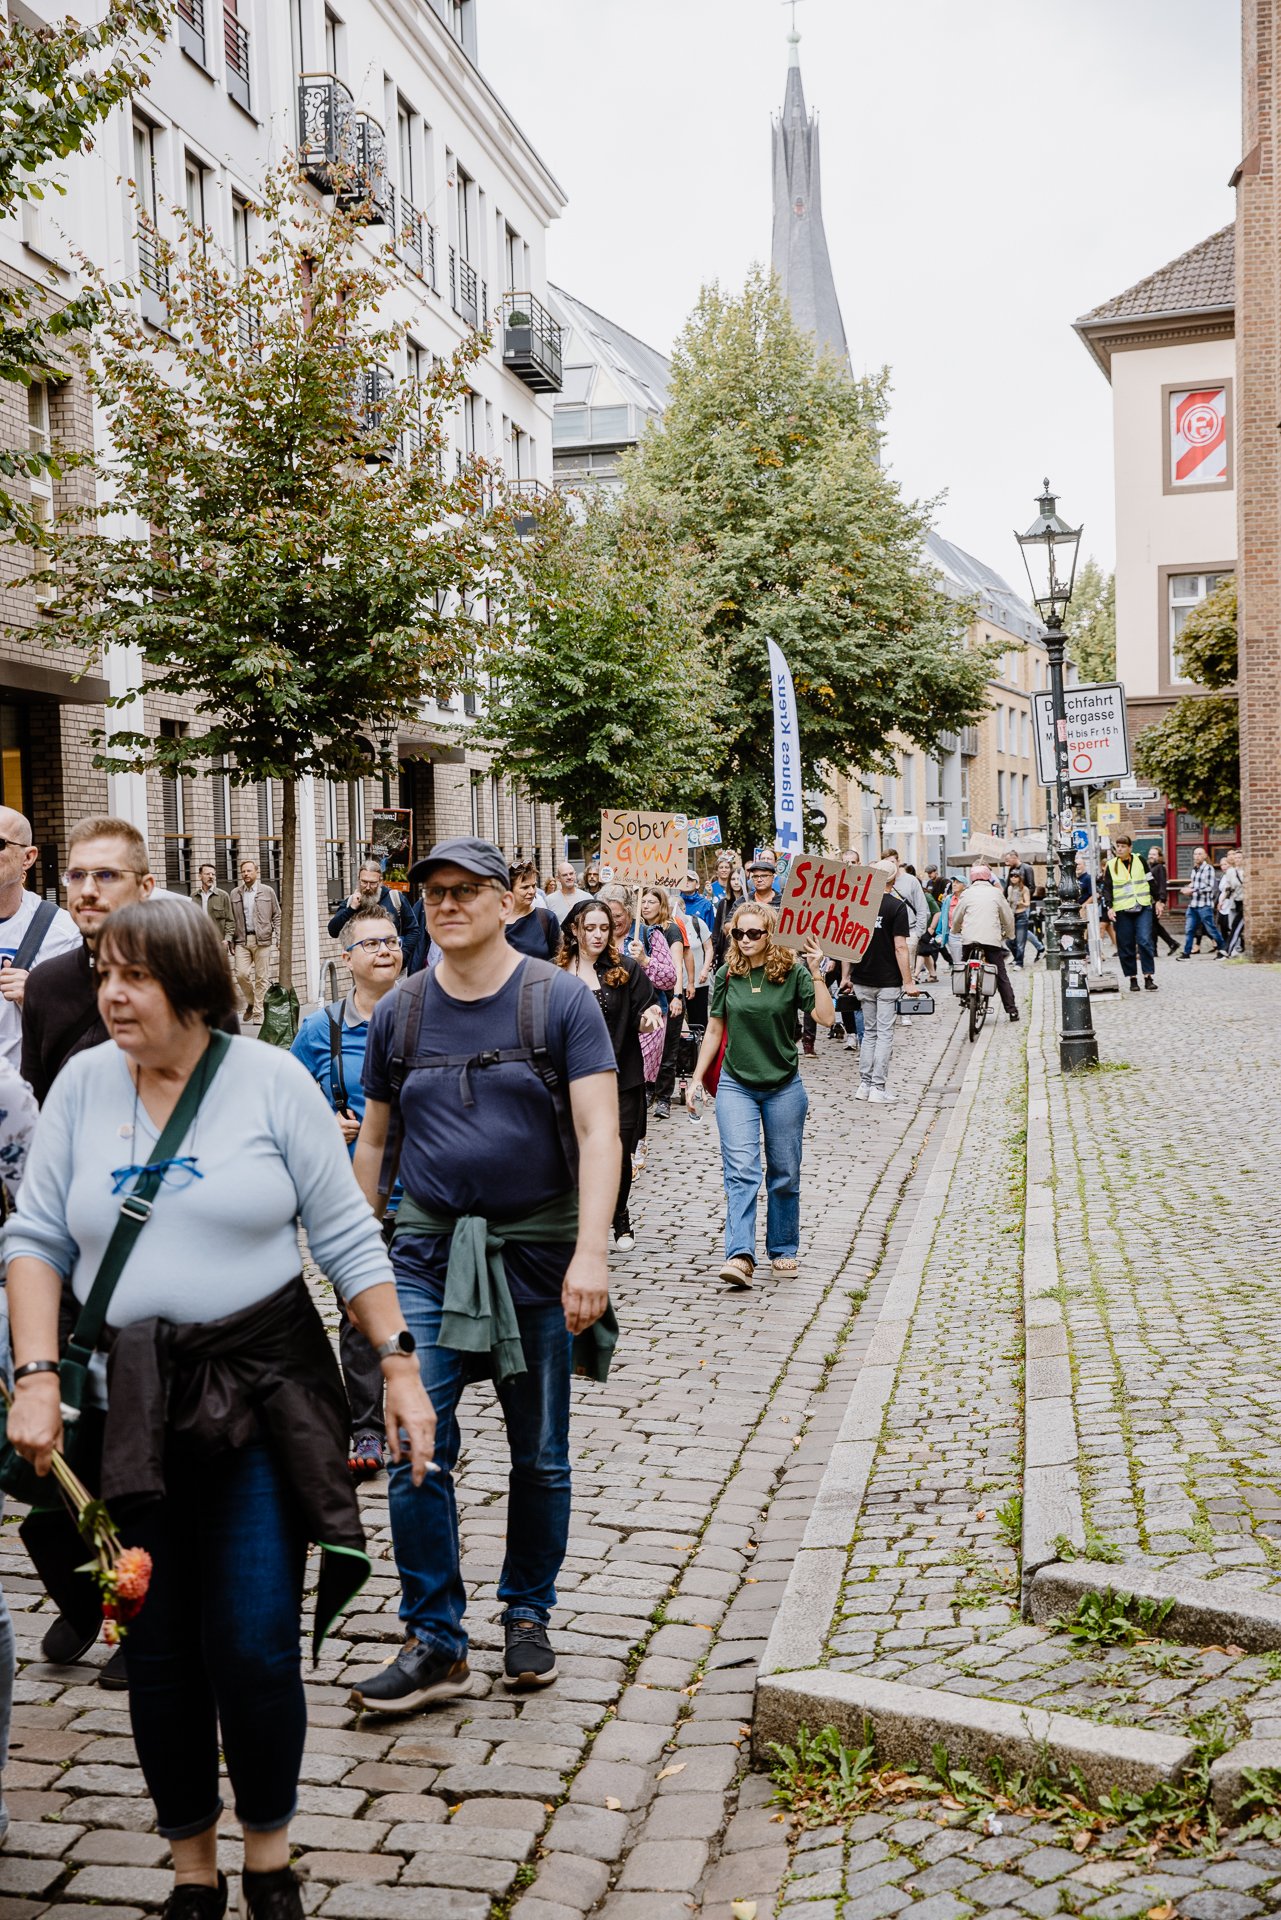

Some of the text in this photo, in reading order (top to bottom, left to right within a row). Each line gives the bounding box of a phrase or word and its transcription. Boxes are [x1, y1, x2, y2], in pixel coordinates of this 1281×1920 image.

[1045, 694, 1113, 712] Dchfahrt
[1047, 711, 1114, 726] Lfergasse
[1076, 730, 1088, 738] bis
[1091, 728, 1099, 736] Fr
[1101, 727, 1111, 735] 15
[1113, 726, 1119, 734] h
[1054, 737, 1110, 752] sperrt
[609, 813, 670, 841] Sober
[778, 900, 870, 955] nüchtern
